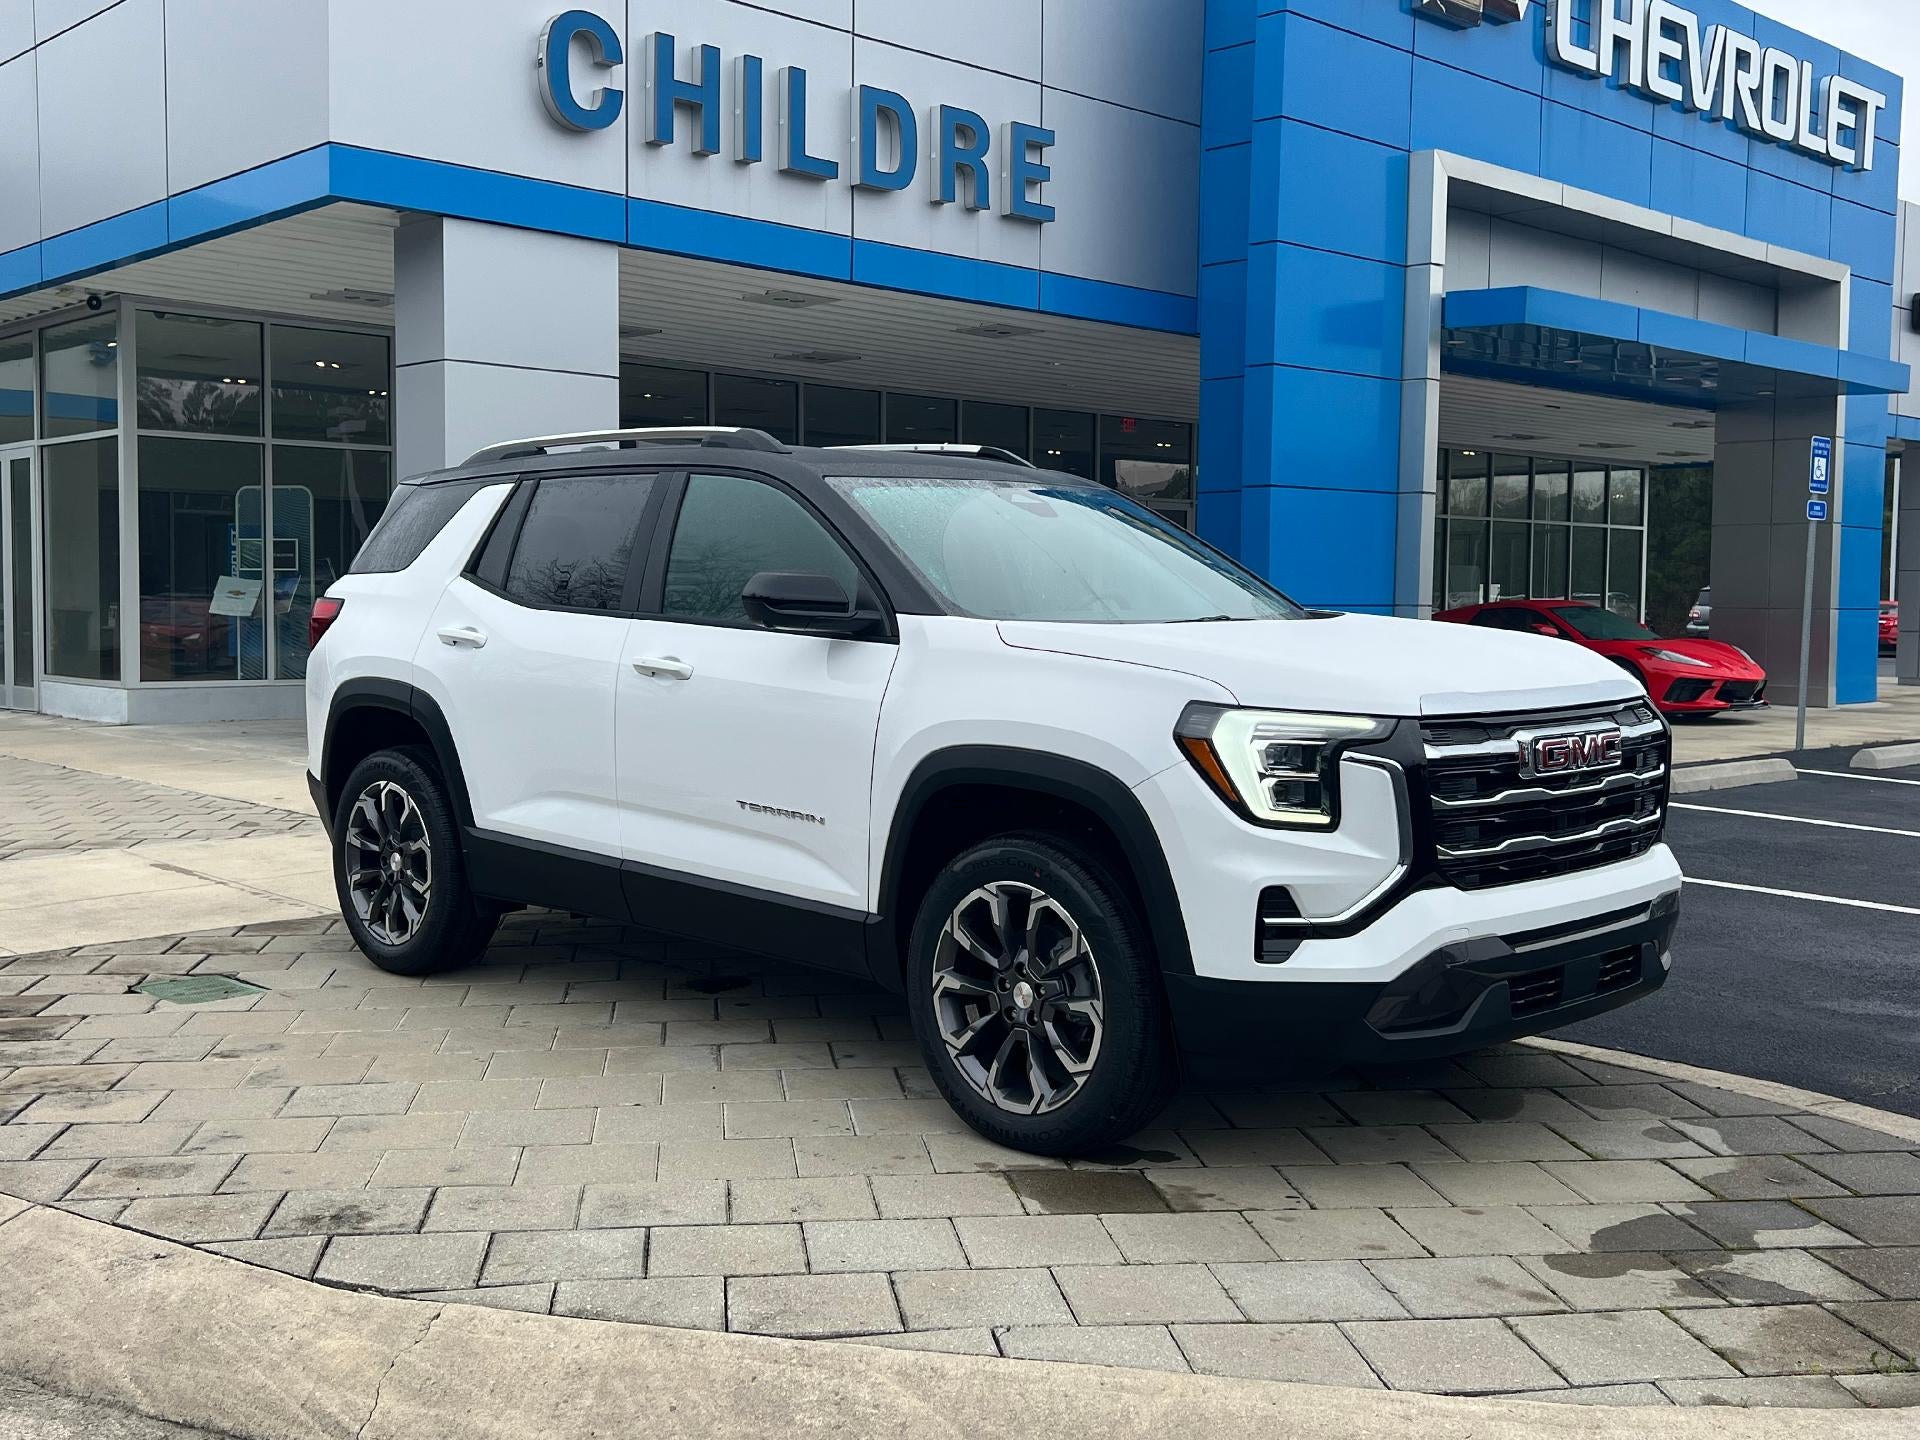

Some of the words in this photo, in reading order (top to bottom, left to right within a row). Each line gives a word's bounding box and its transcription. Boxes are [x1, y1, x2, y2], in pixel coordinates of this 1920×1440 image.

[539, 10, 1055, 222] CHILDRE
[1549, 0, 1886, 170] CHEVROLET
[1538, 730, 1622, 771] GMC
[736, 799, 825, 825] TERRAIN
